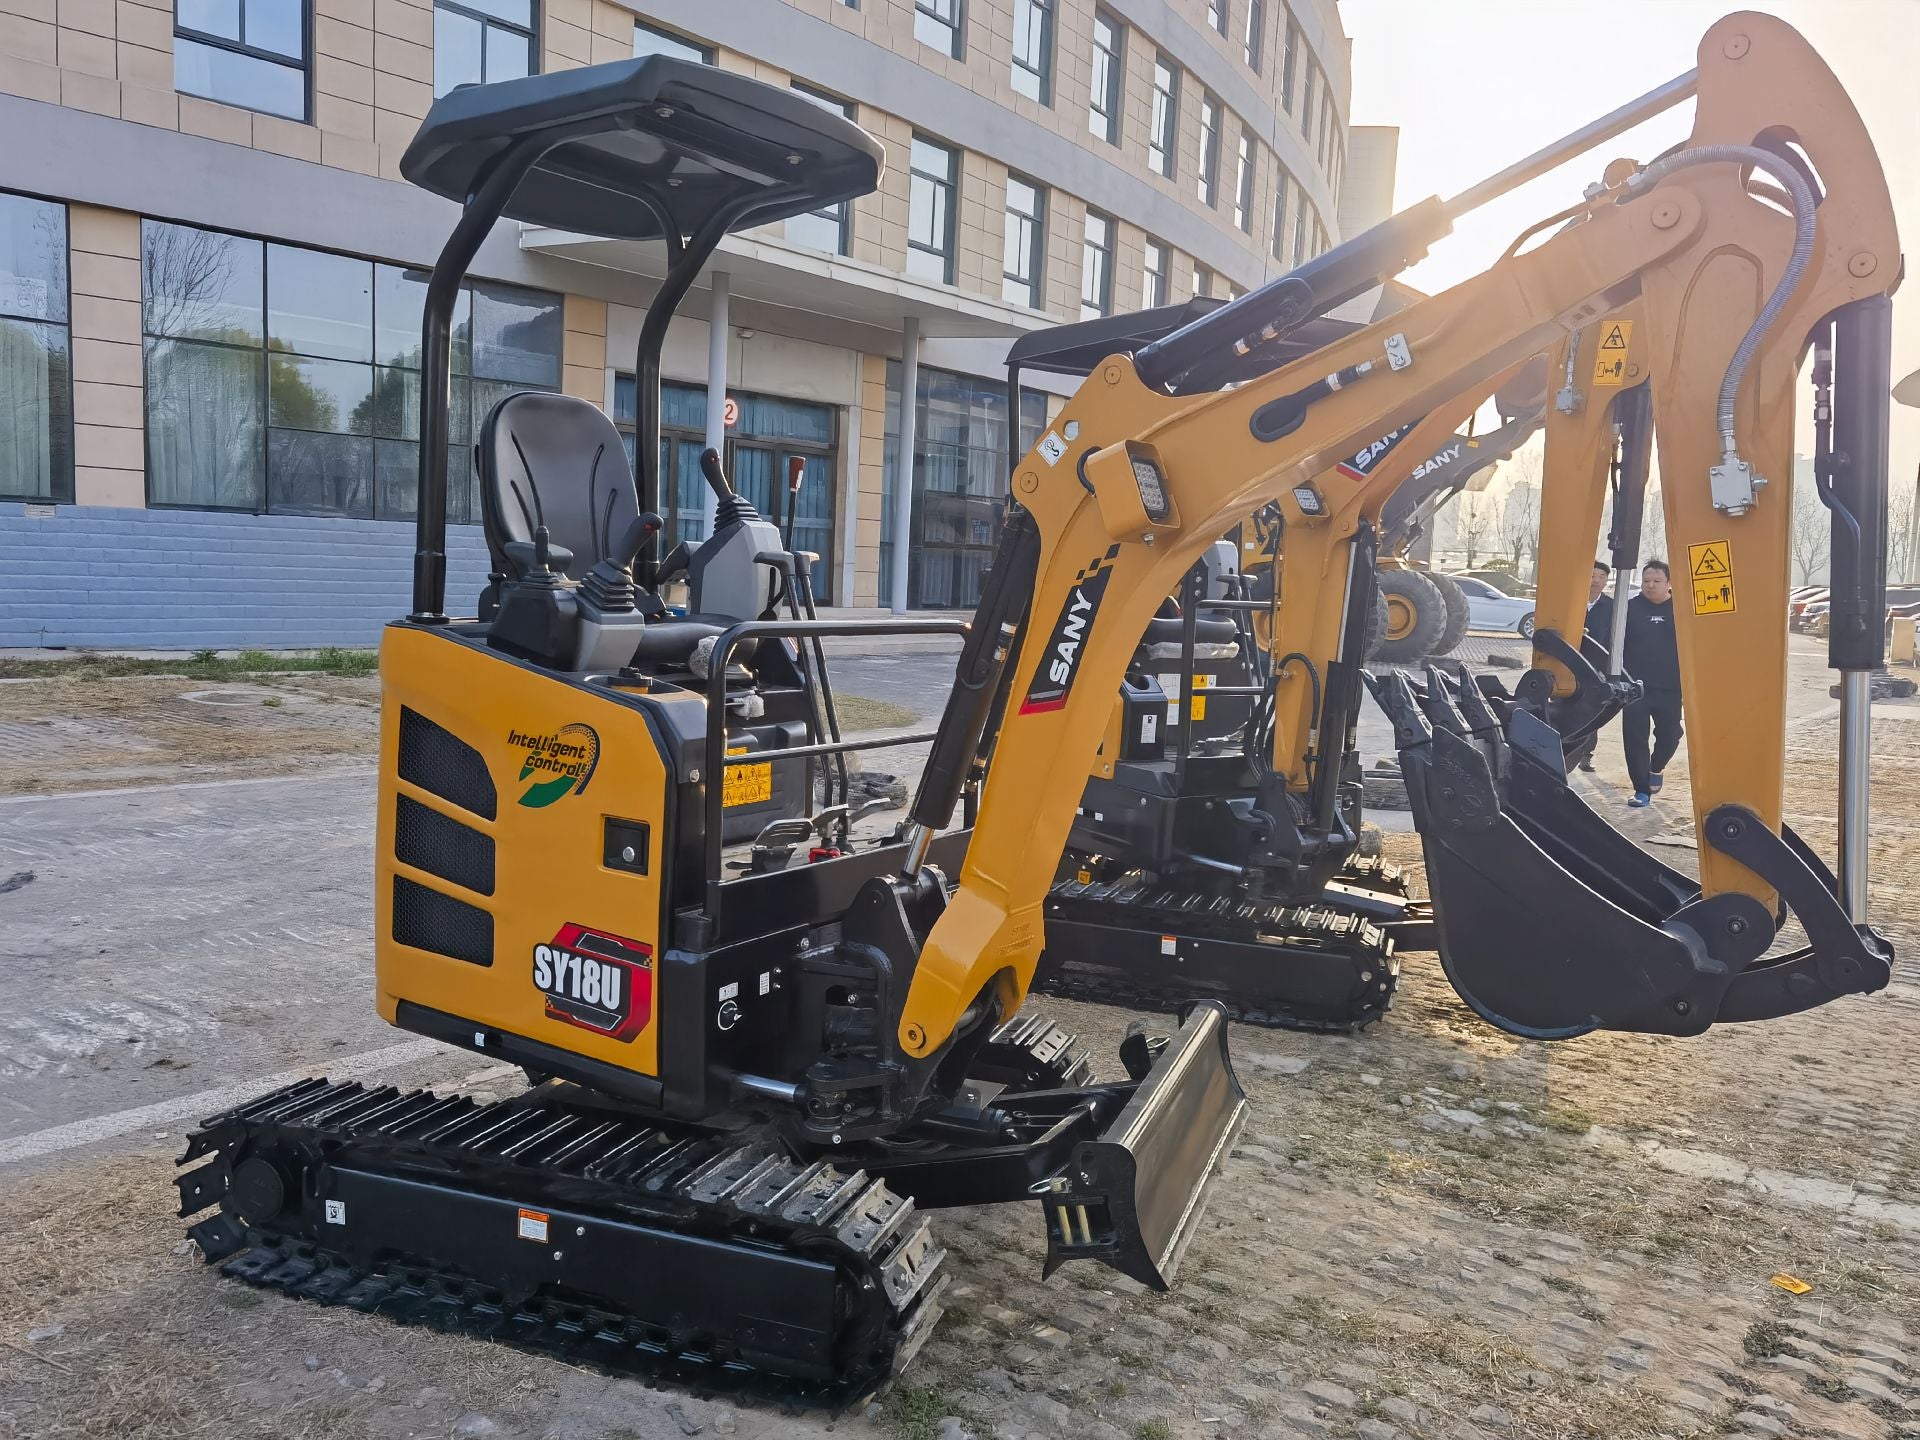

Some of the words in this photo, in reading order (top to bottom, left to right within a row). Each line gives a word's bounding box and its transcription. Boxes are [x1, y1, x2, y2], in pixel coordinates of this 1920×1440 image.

[725, 403, 734, 420] 2
[1355, 424, 1409, 470] SAN
[1412, 444, 1460, 480] SANY
[1049, 588, 1093, 685] SANY
[507, 730, 587, 759] Intelligent
[525, 755, 583, 777] control
[534, 945, 621, 1010] SY18U
